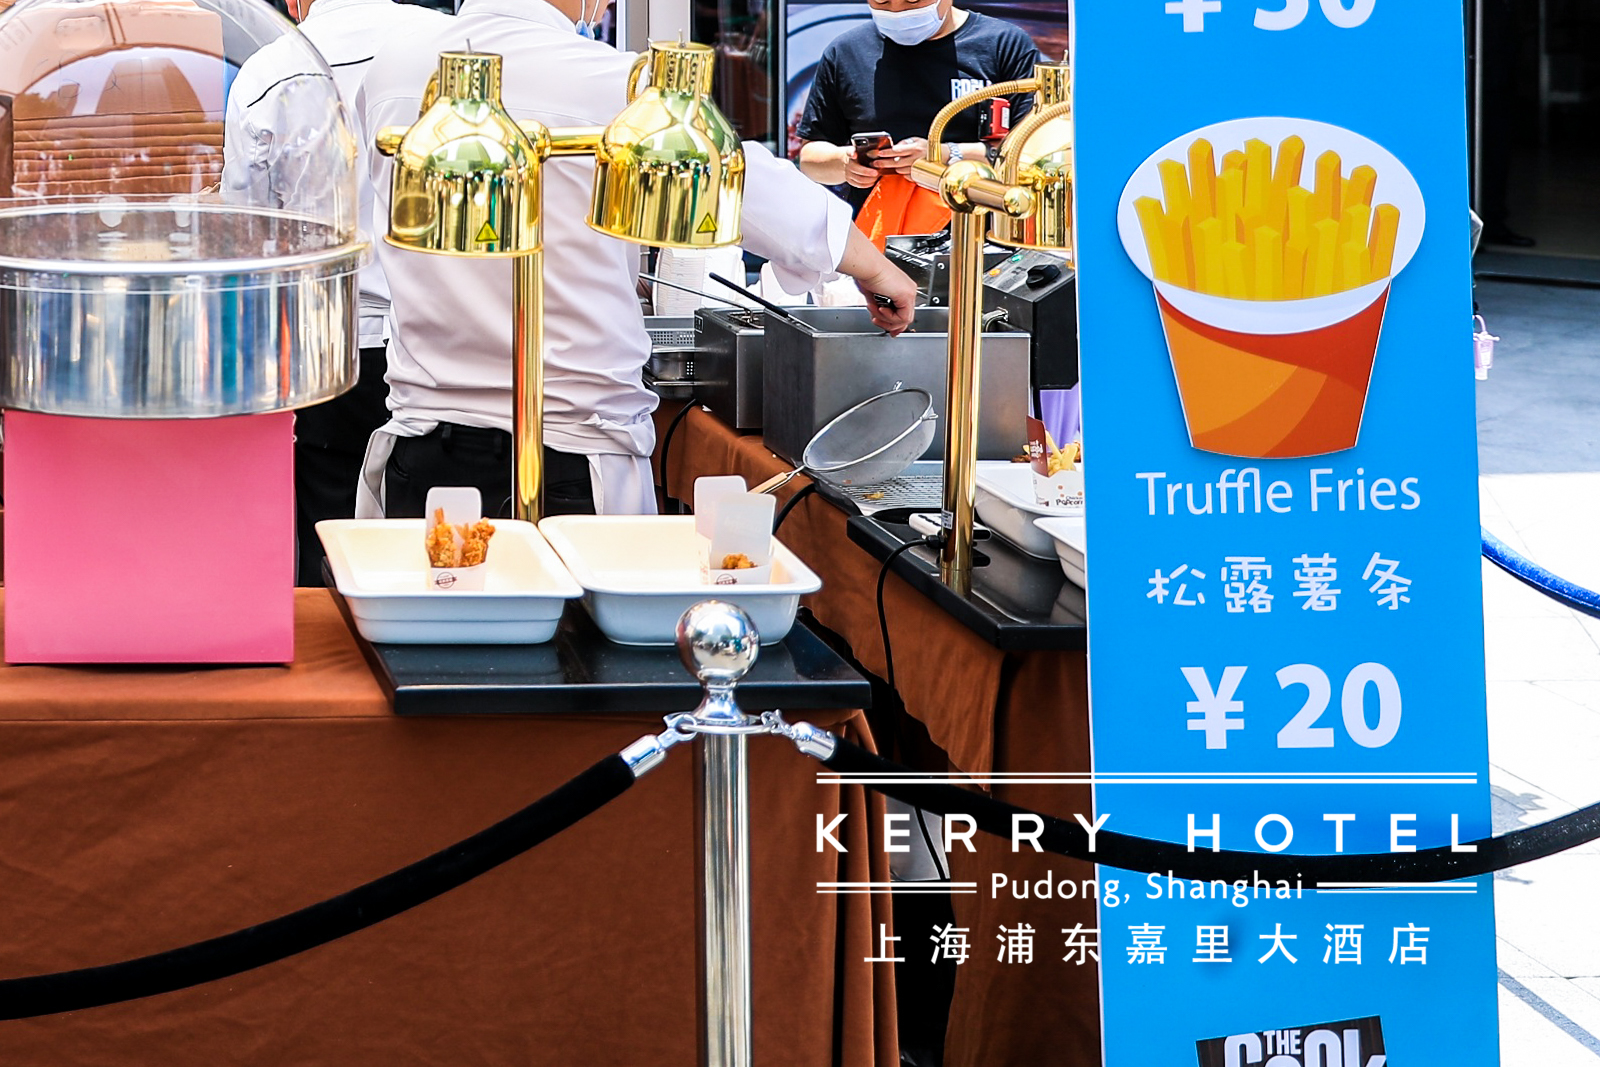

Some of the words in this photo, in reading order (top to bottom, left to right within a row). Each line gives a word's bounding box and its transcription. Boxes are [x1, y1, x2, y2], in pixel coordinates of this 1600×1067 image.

[1136, 467, 1293, 517] Truffle
[1310, 465, 1421, 512] Fries
[1146, 552, 1414, 616] 松露薯条
[1263, 1029, 1301, 1055] THE
